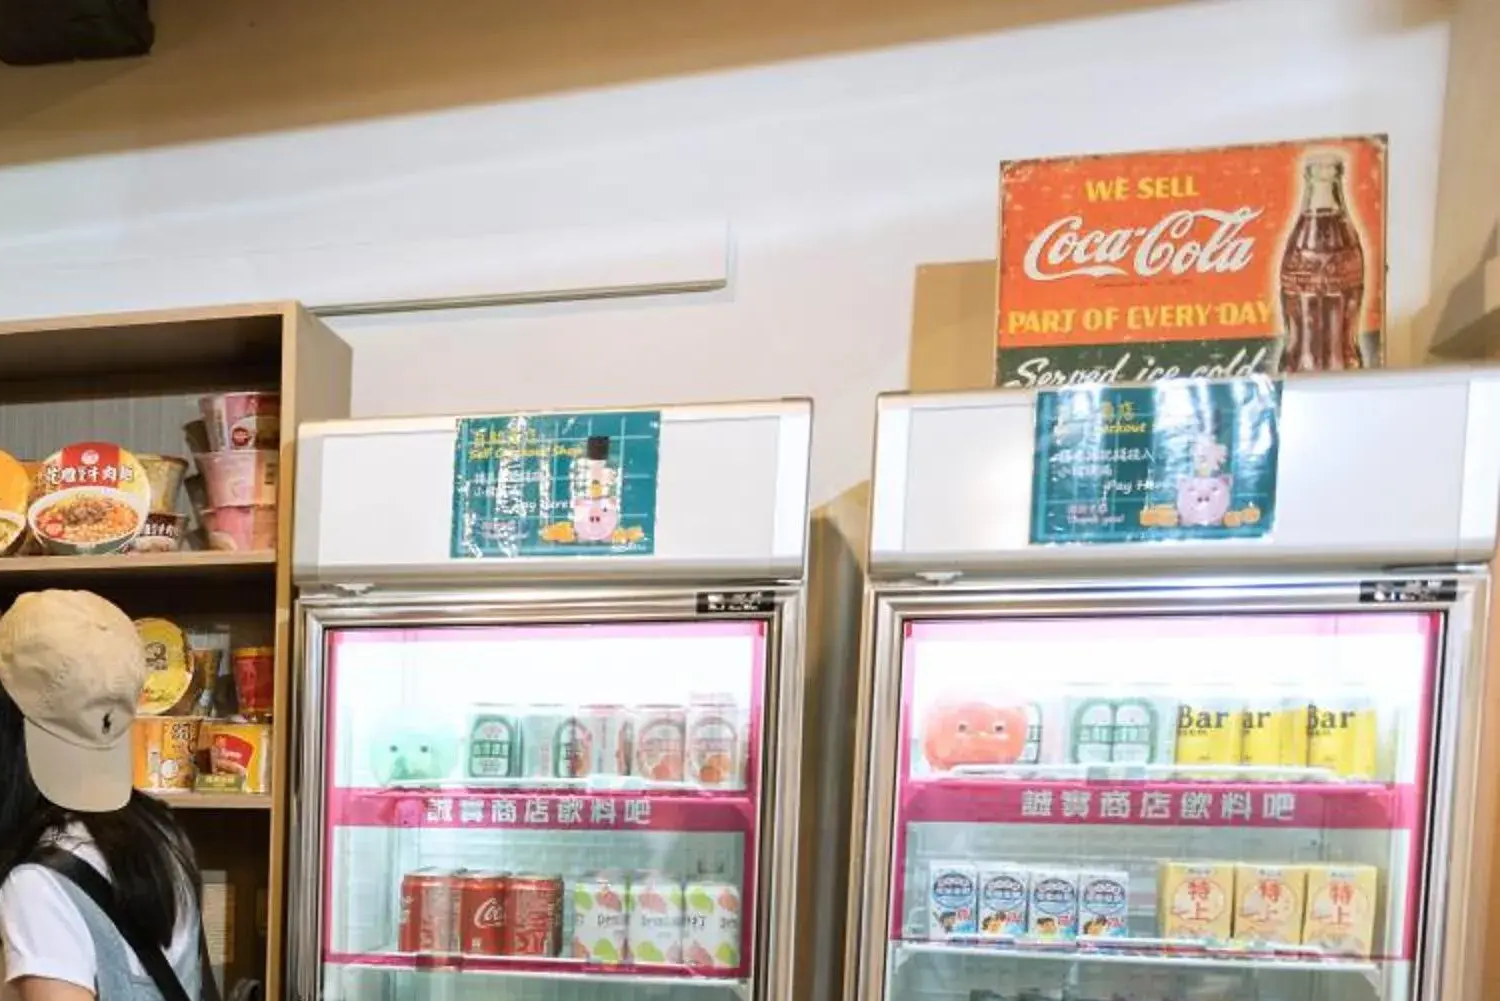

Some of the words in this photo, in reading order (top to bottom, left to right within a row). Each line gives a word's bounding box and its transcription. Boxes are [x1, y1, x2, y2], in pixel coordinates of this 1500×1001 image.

[1085, 175, 1131, 202] WE
[1137, 171, 1200, 199] SELL
[1023, 206, 1265, 281] Coca-Cola
[1007, 306, 1076, 334] PART
[1083, 305, 1120, 331] OF
[1127, 302, 1209, 330] EVERY
[1218, 301, 1274, 326] DAY
[1006, 353, 1131, 388] Served
[1136, 359, 1180, 382] ice
[1188, 346, 1268, 380] cold
[1177, 704, 1230, 730] Bar
